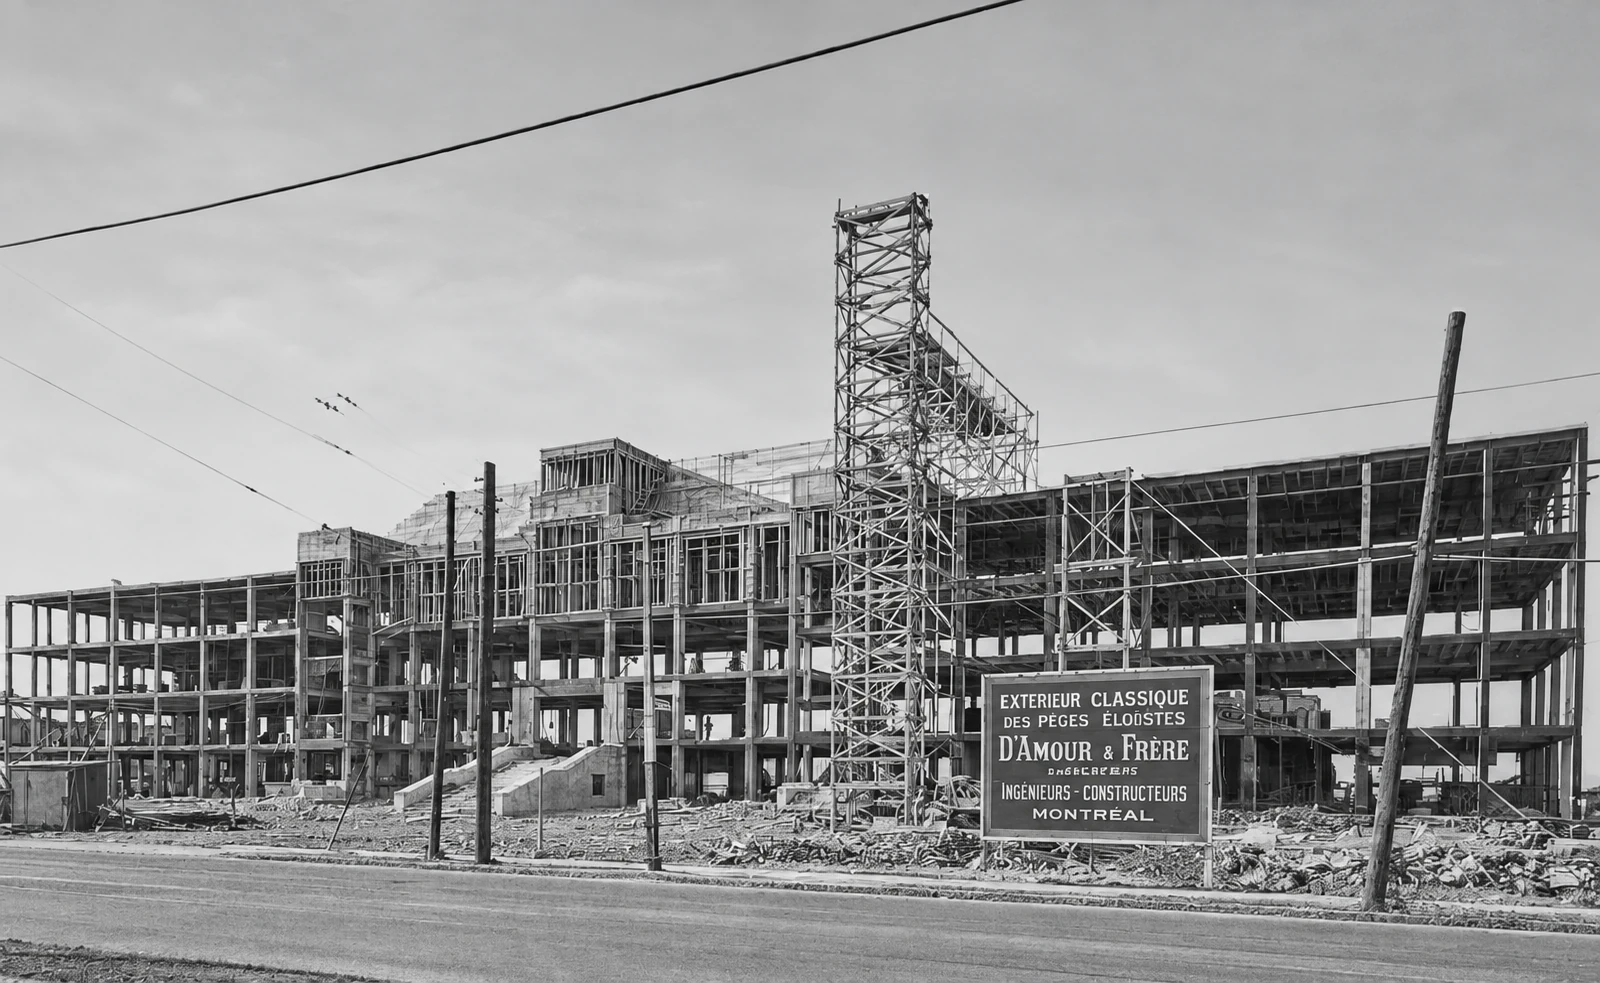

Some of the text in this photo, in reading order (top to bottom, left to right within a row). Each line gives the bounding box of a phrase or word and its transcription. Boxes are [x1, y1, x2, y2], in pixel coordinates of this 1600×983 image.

[1000, 689, 1189, 709] EXTERIEUR CLASSIQUE
[1004, 716, 1031, 728] DES
[1103, 745, 1114, 760] &
[1083, 785, 1187, 802] CONSTRUCTEURS
[1032, 807, 1154, 821] MONTRÉAL
